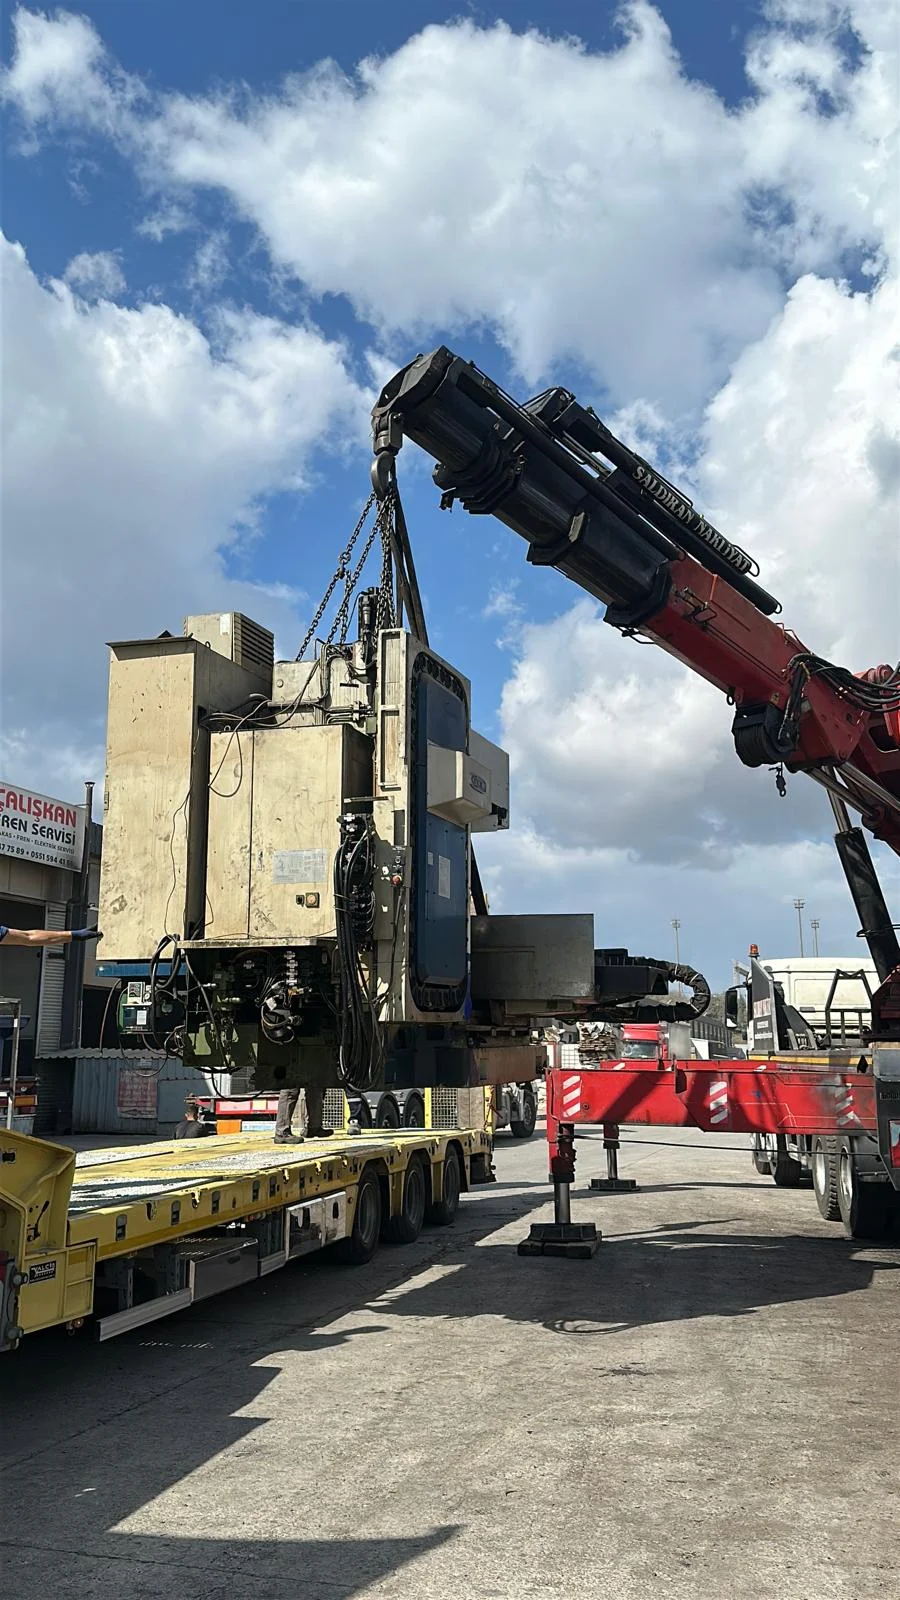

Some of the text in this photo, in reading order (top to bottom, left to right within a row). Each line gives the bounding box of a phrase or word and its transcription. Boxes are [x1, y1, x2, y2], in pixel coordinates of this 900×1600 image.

[632, 466, 695, 525] SALDIRAN
[0, 813, 76, 846] REN SERVİSİ
[31, 850, 45, 861] 0551
